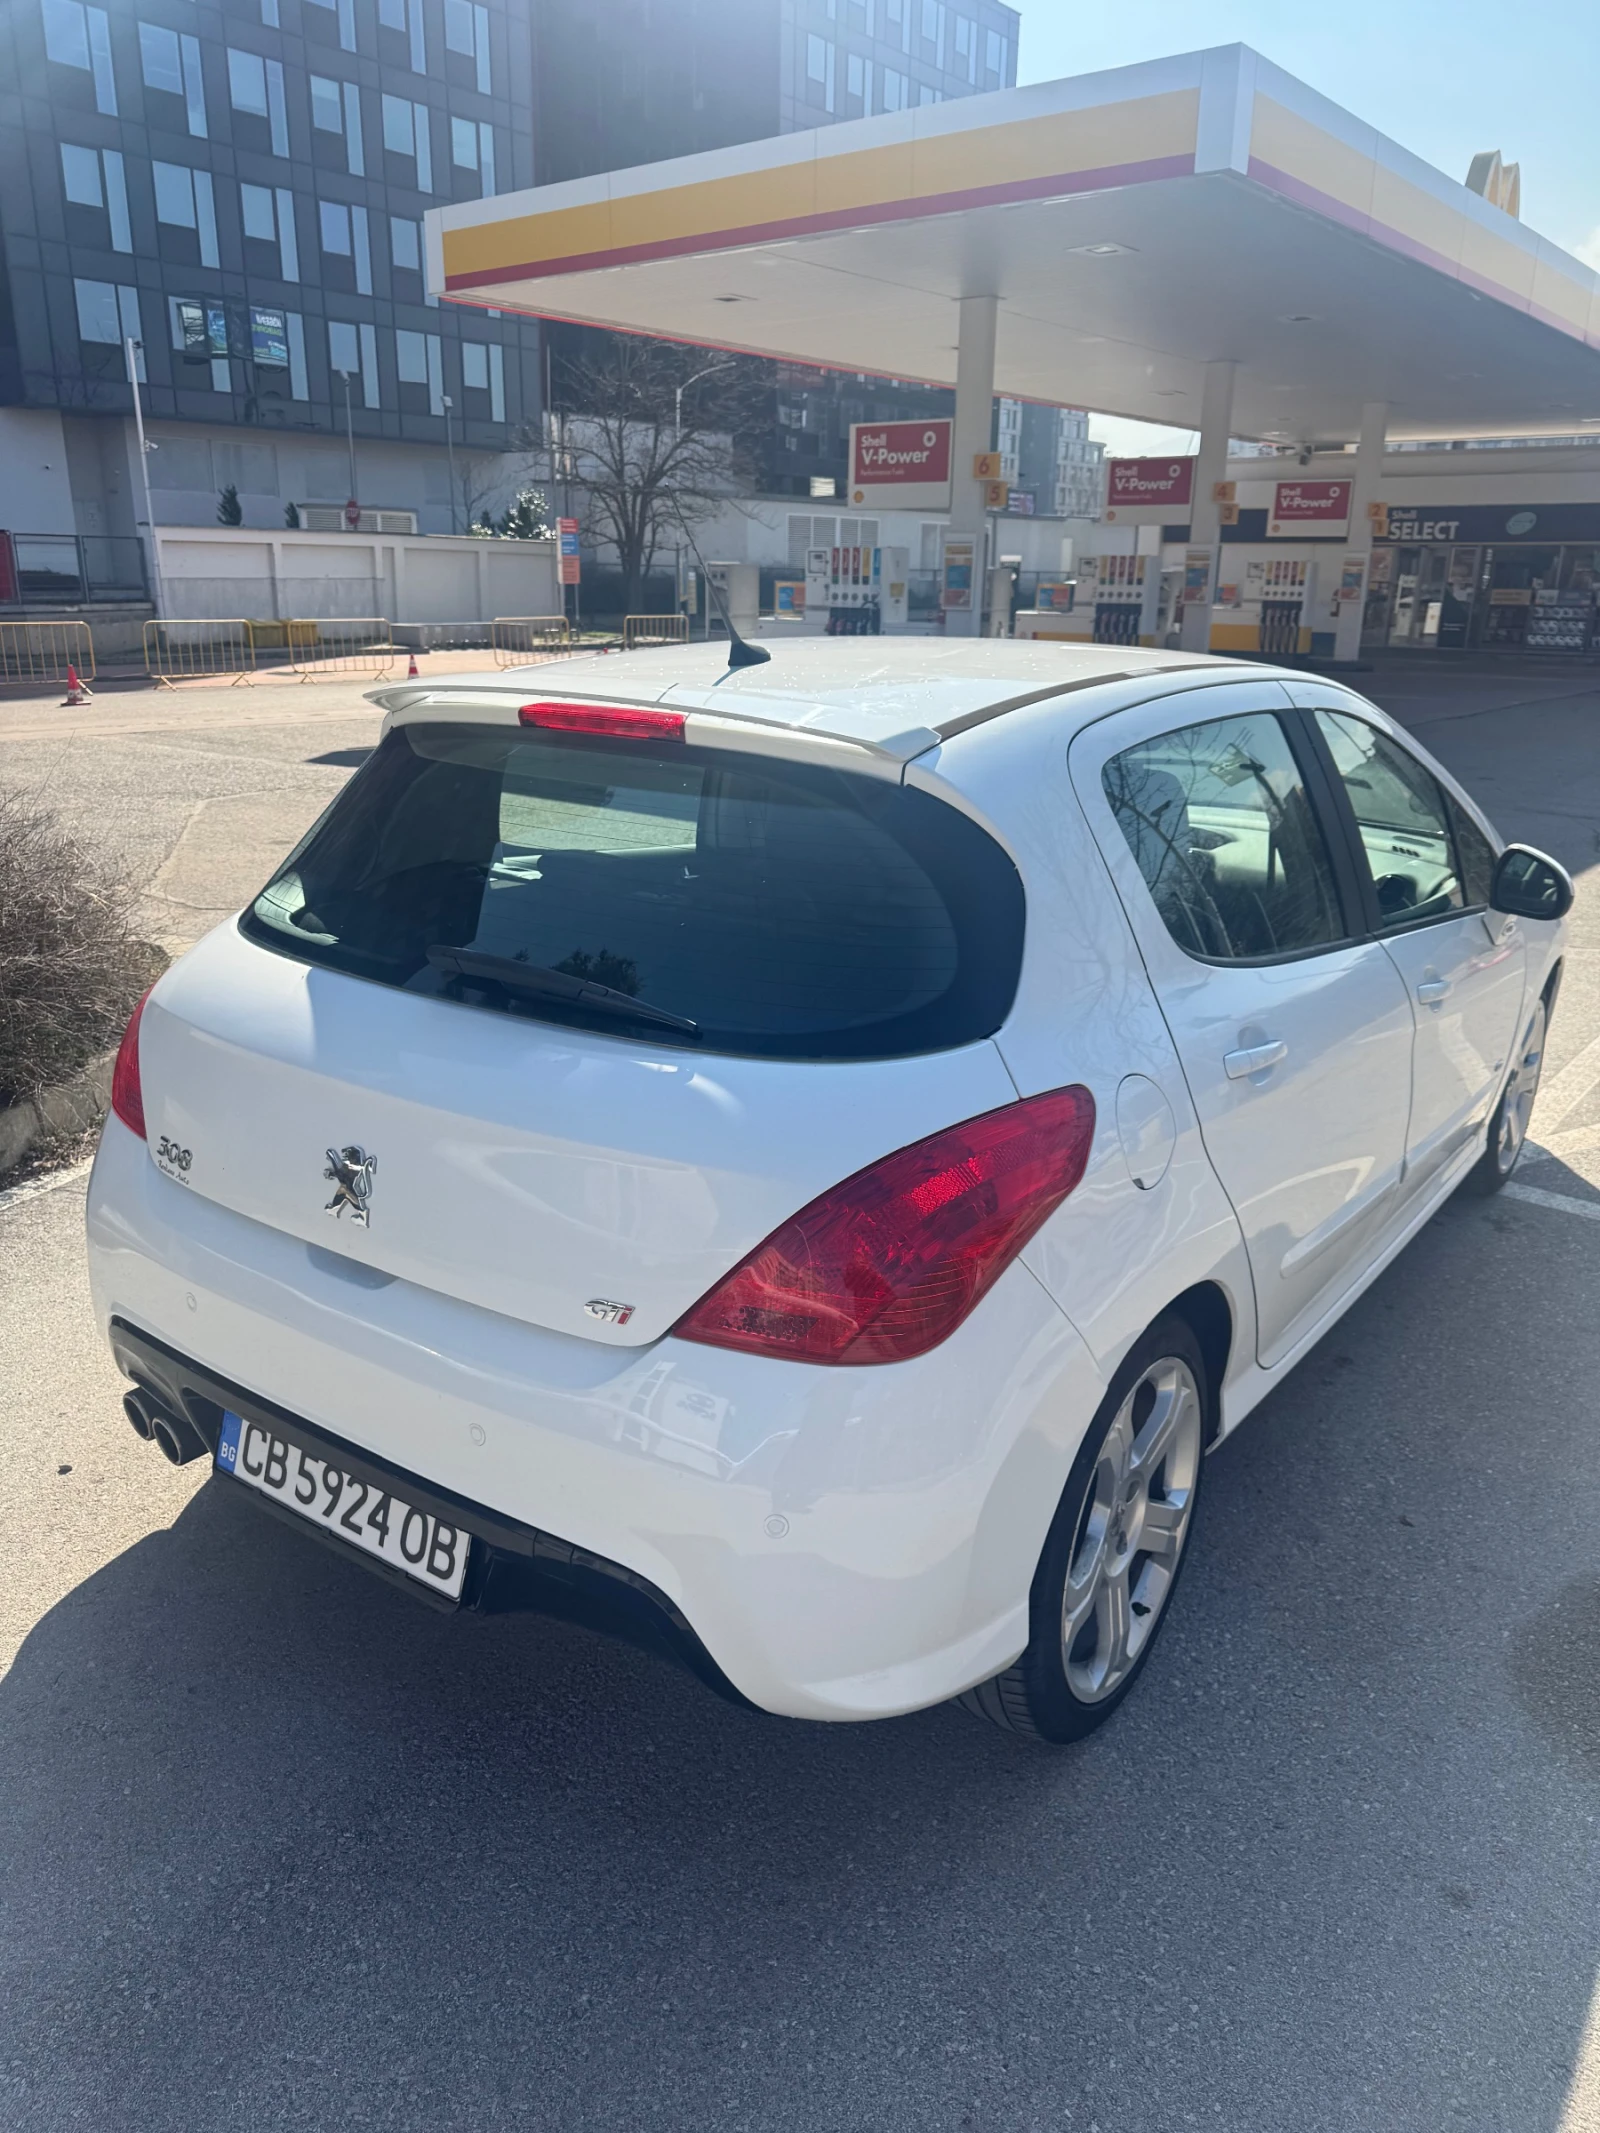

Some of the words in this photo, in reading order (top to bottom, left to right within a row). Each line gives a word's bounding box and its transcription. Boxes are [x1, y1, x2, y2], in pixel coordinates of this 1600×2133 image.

[861, 433, 887, 447] Shell
[861, 448, 930, 465] V-Power
[979, 456, 990, 475] 6
[1115, 466, 1139, 477] Shell
[1115, 478, 1175, 491] V-Power
[1280, 487, 1302, 497] Shell
[990, 485, 1001, 502] 5
[1280, 497, 1335, 508] V-Power
[1391, 509, 1418, 520] Shell
[1389, 521, 1460, 540] SELECT
[156, 1135, 193, 1171] 308
[220, 1440, 237, 1463] BG
[242, 1423, 289, 1489] CB
[295, 1451, 392, 1549] 5924
[400, 1506, 458, 1581] OB
